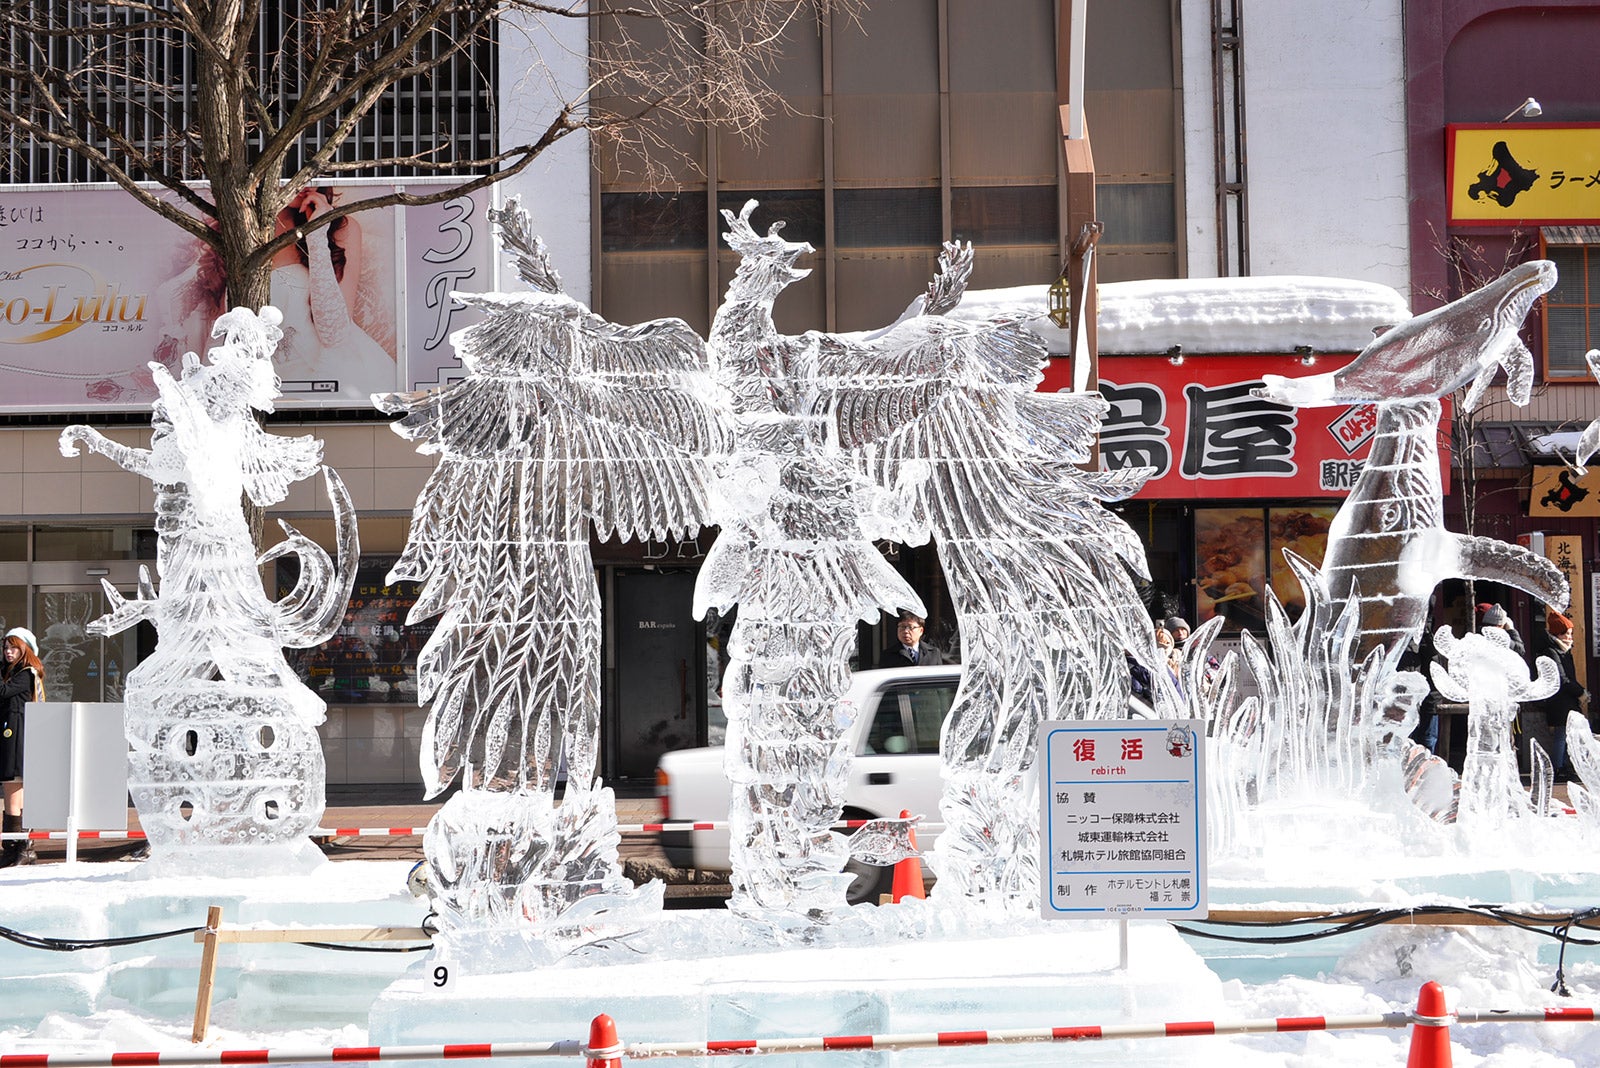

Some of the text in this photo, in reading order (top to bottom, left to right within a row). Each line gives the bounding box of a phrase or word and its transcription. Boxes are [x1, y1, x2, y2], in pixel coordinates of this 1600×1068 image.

[0, 282, 149, 326] o-Lulu
[639, 621, 657, 629] BAR
[1073, 738, 1143, 762] 復活
[1091, 766, 1126, 775] rebirth
[1056, 792, 1096, 804] 協賛
[1078, 831, 1169, 843] 城東運輸株式会社
[1061, 849, 1187, 862] 札幌ホテル旅館協同組合
[433, 965, 449, 987] 9
